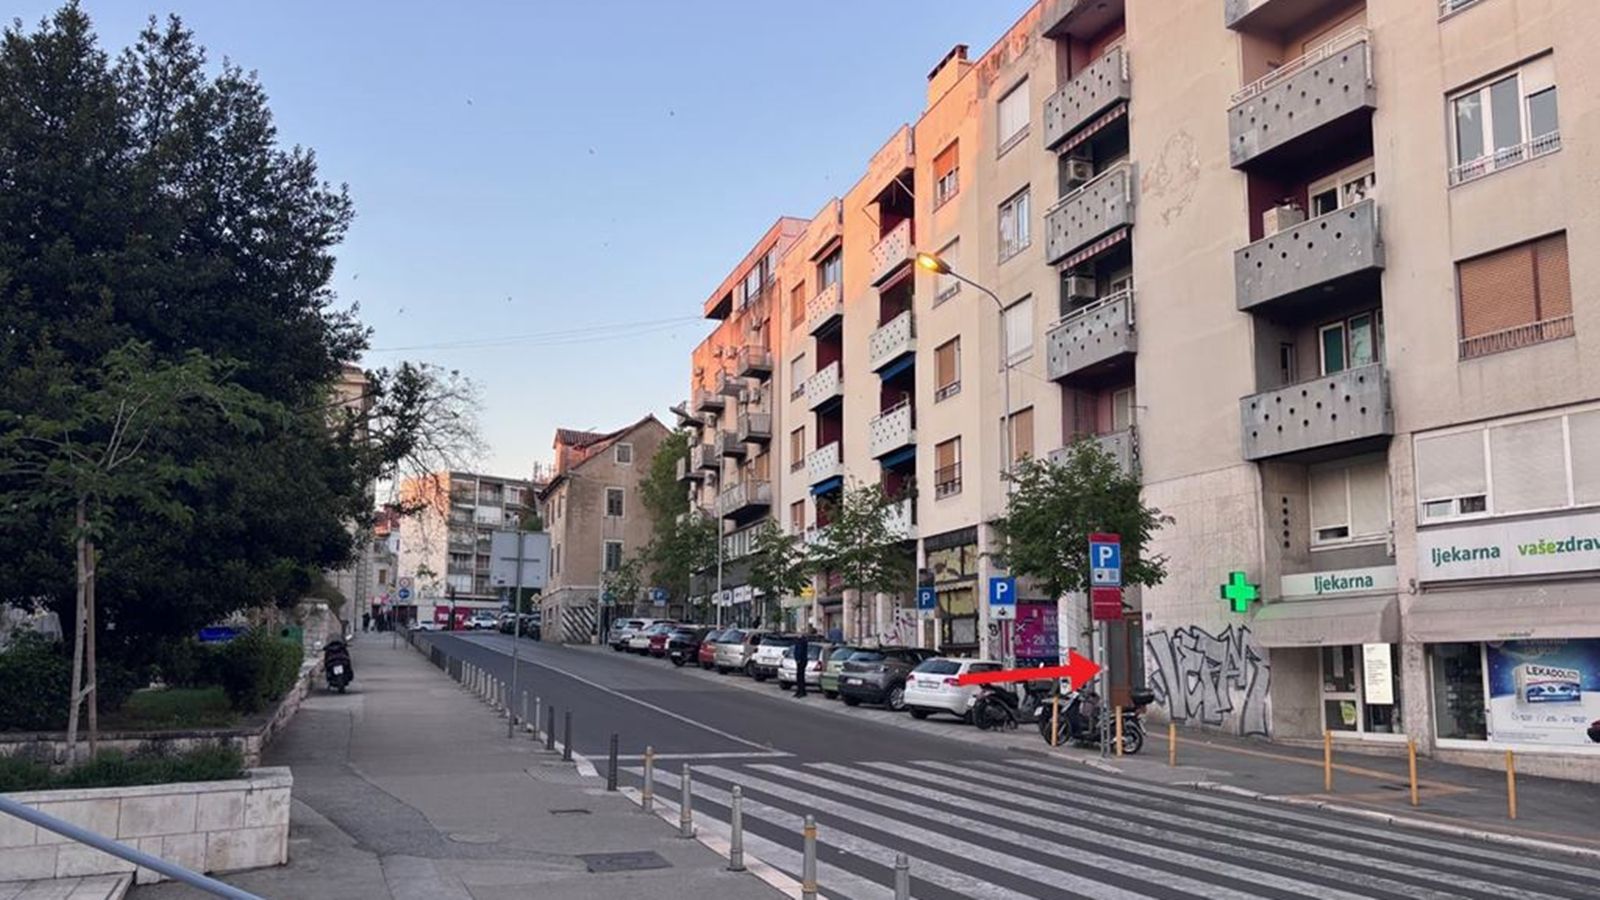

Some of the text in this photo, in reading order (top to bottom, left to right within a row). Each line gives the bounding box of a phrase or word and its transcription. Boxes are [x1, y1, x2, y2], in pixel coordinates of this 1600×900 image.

[1099, 545, 1113, 568] P
[1432, 546, 1500, 567] ljekarna
[996, 582, 1008, 600] P
[1314, 574, 1374, 595] ljekarna
[921, 592, 931, 606] P
